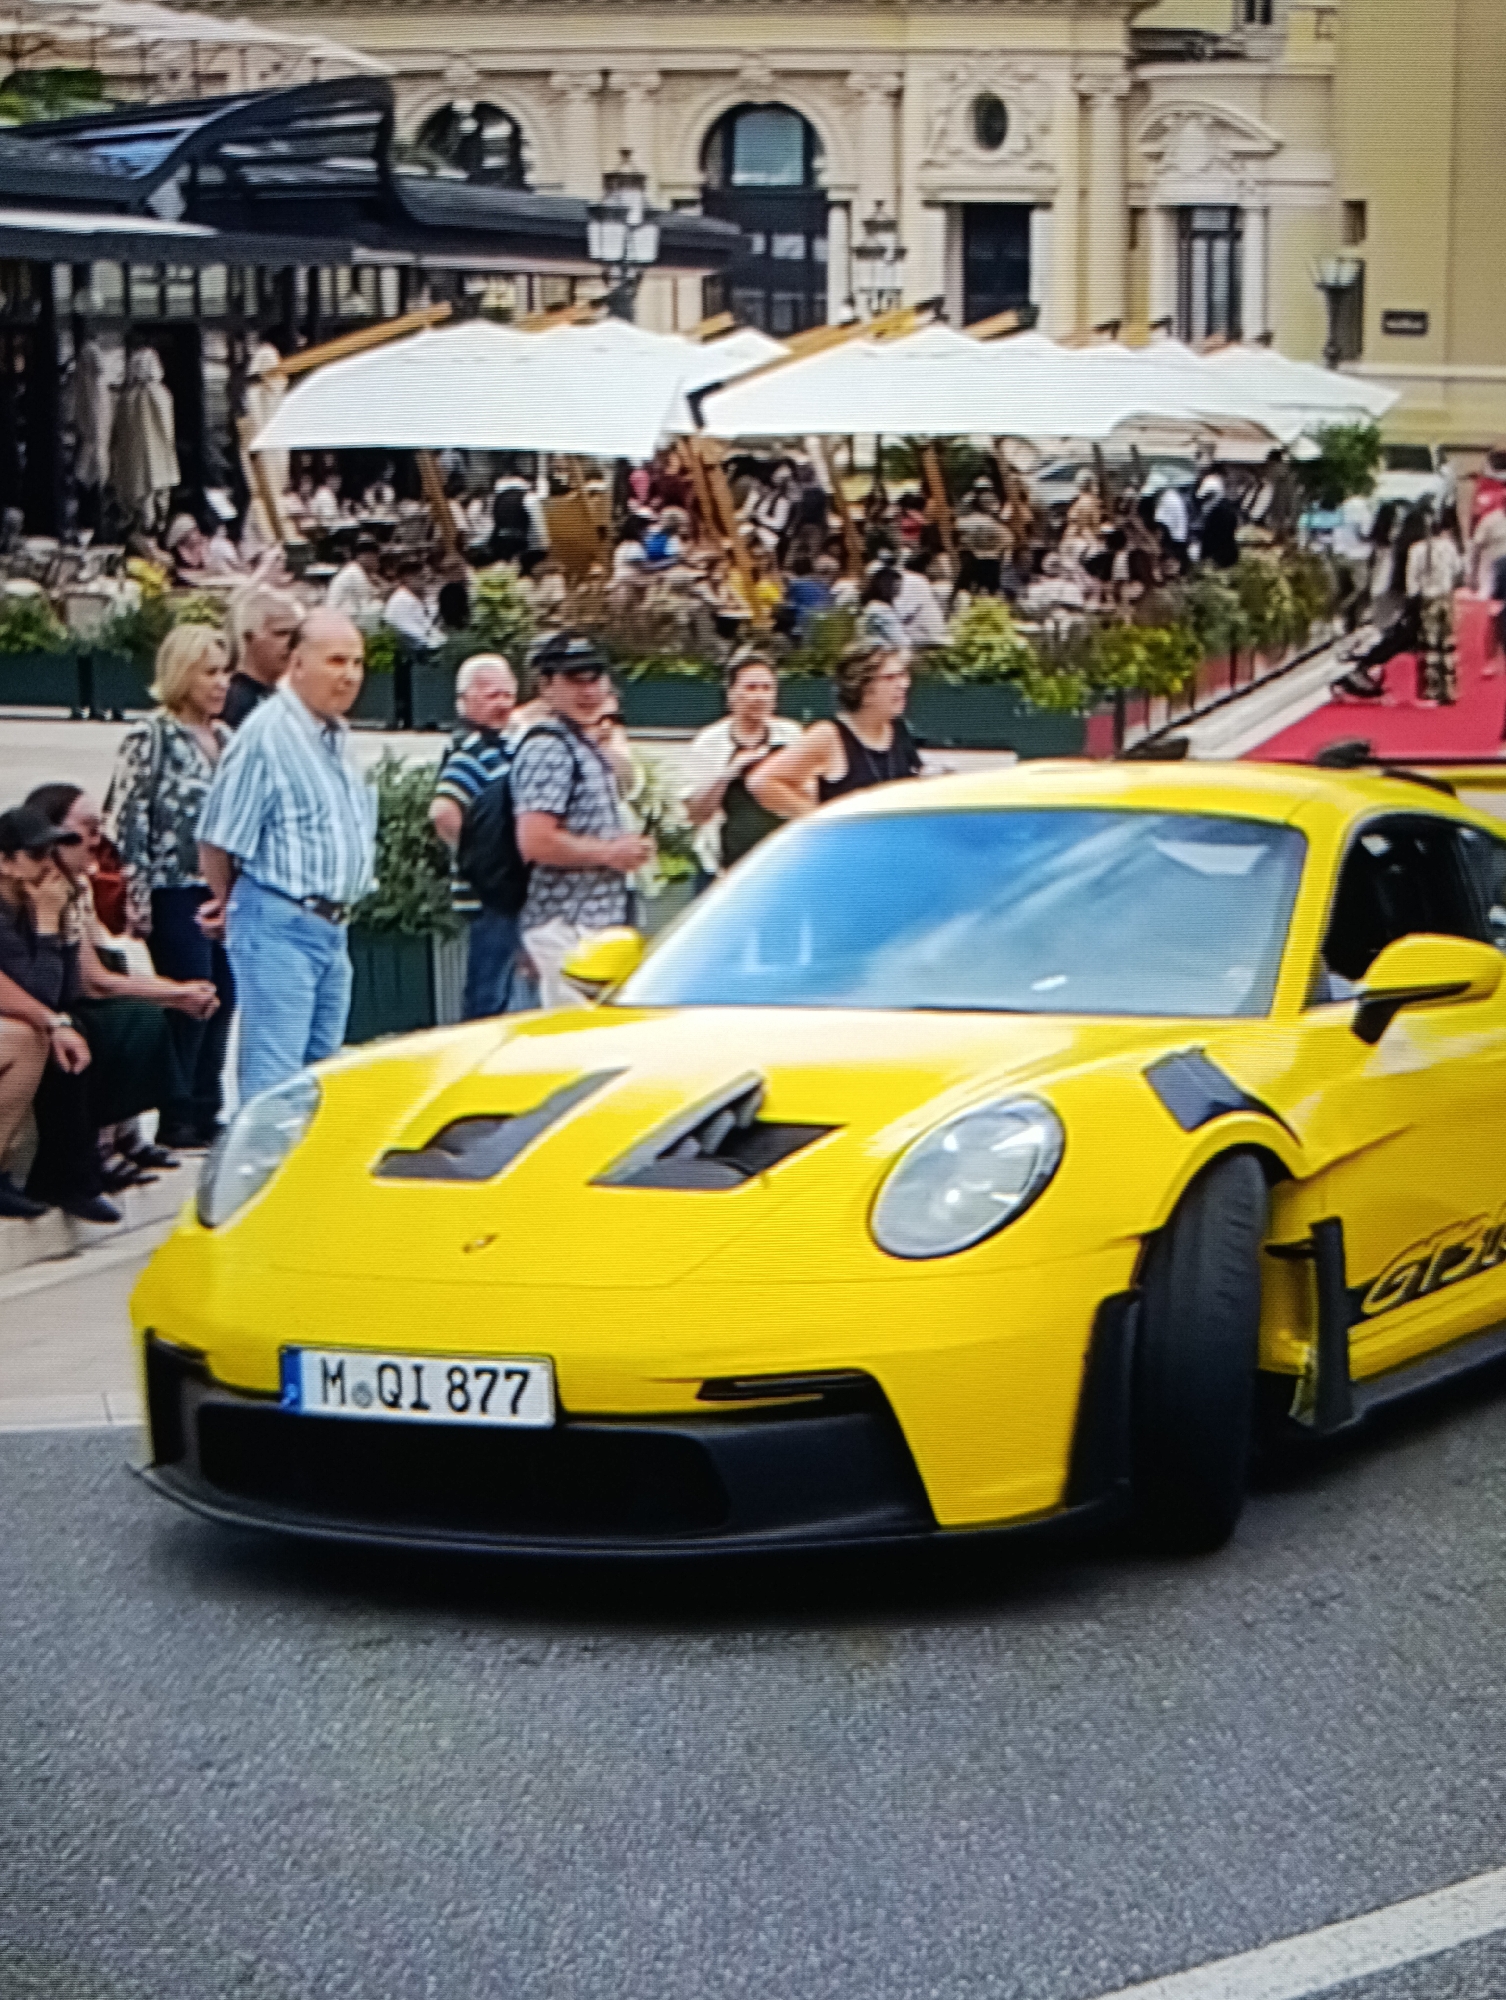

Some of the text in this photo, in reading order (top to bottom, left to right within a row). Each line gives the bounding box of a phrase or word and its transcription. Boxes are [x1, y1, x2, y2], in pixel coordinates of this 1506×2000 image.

[321, 1356, 346, 1405] M
[377, 1362, 431, 1411] QI
[447, 1365, 531, 1416] 877
